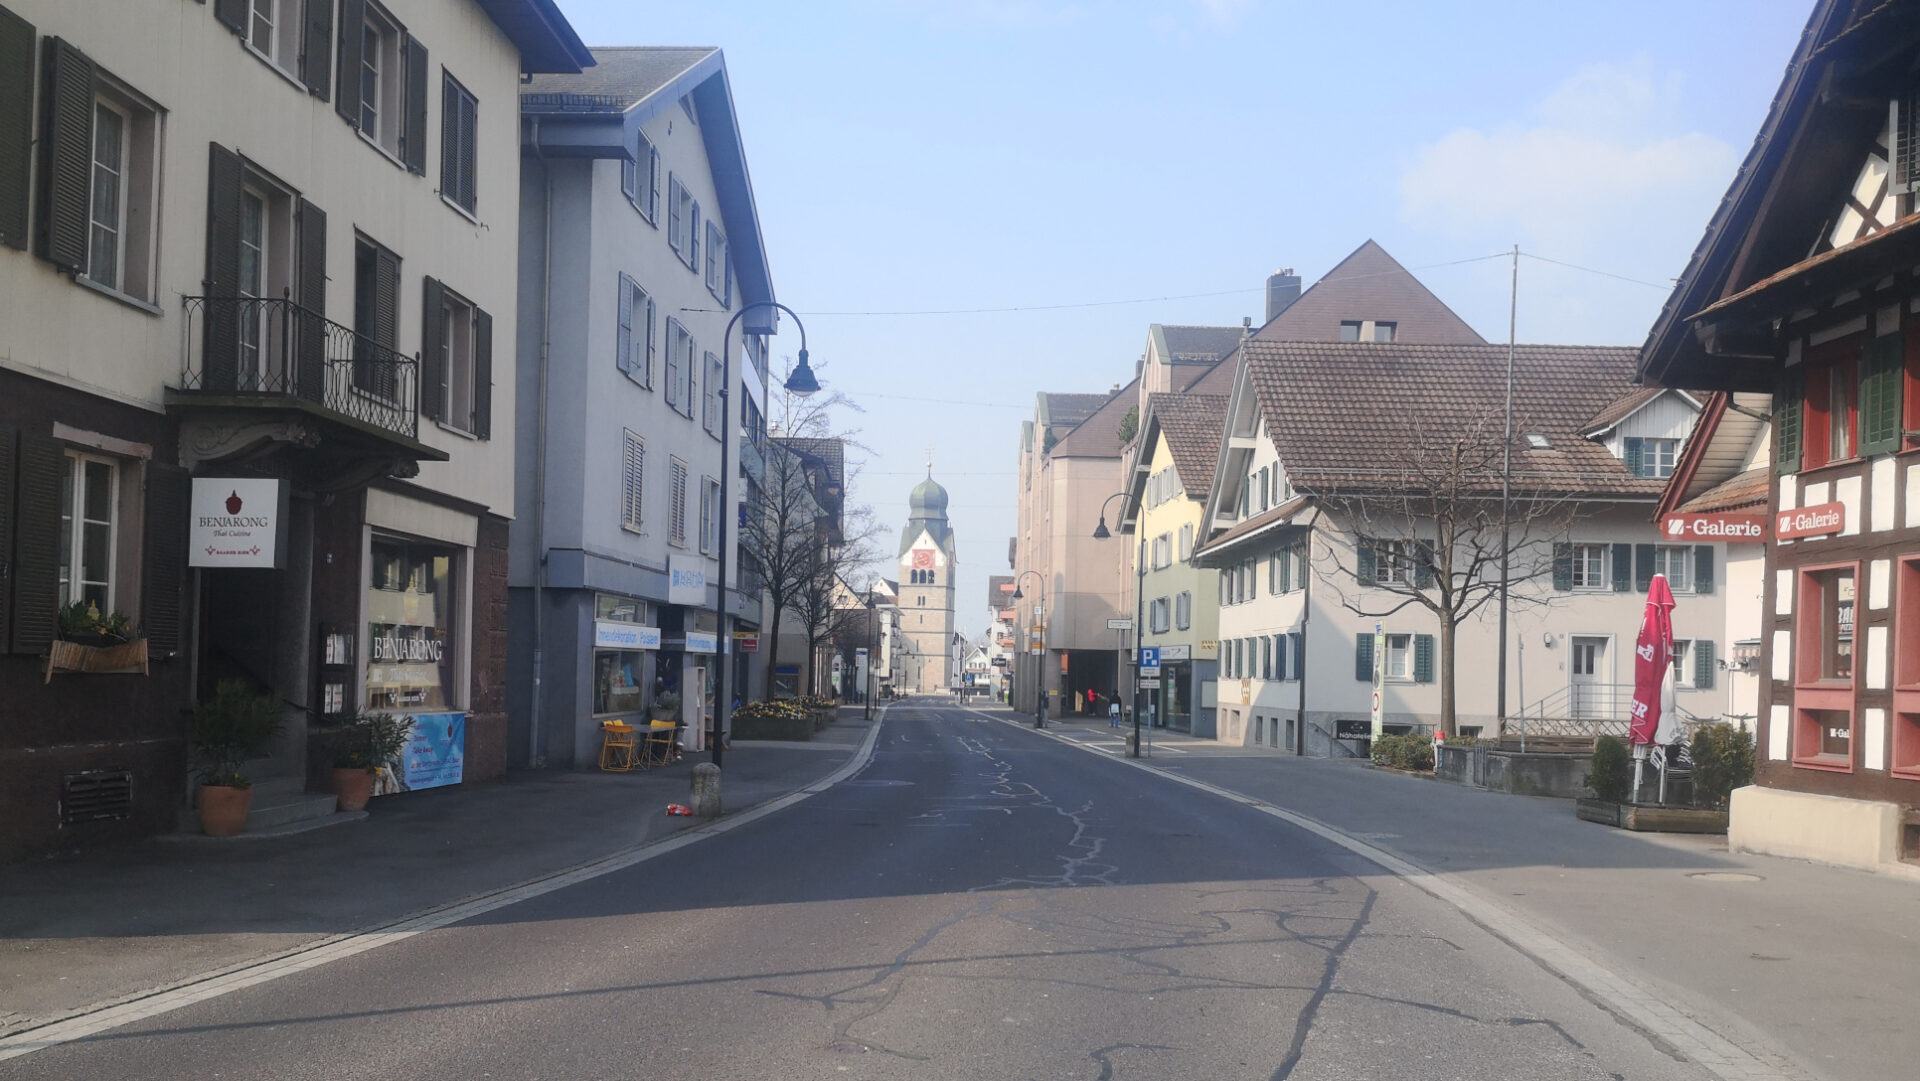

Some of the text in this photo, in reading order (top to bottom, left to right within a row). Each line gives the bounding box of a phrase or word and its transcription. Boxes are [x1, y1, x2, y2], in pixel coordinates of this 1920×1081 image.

[199, 516, 269, 528] BENJARONG
[374, 636, 442, 660] BENJARONG
[1143, 649, 1153, 665] P
[1630, 699, 1648, 718] ER
